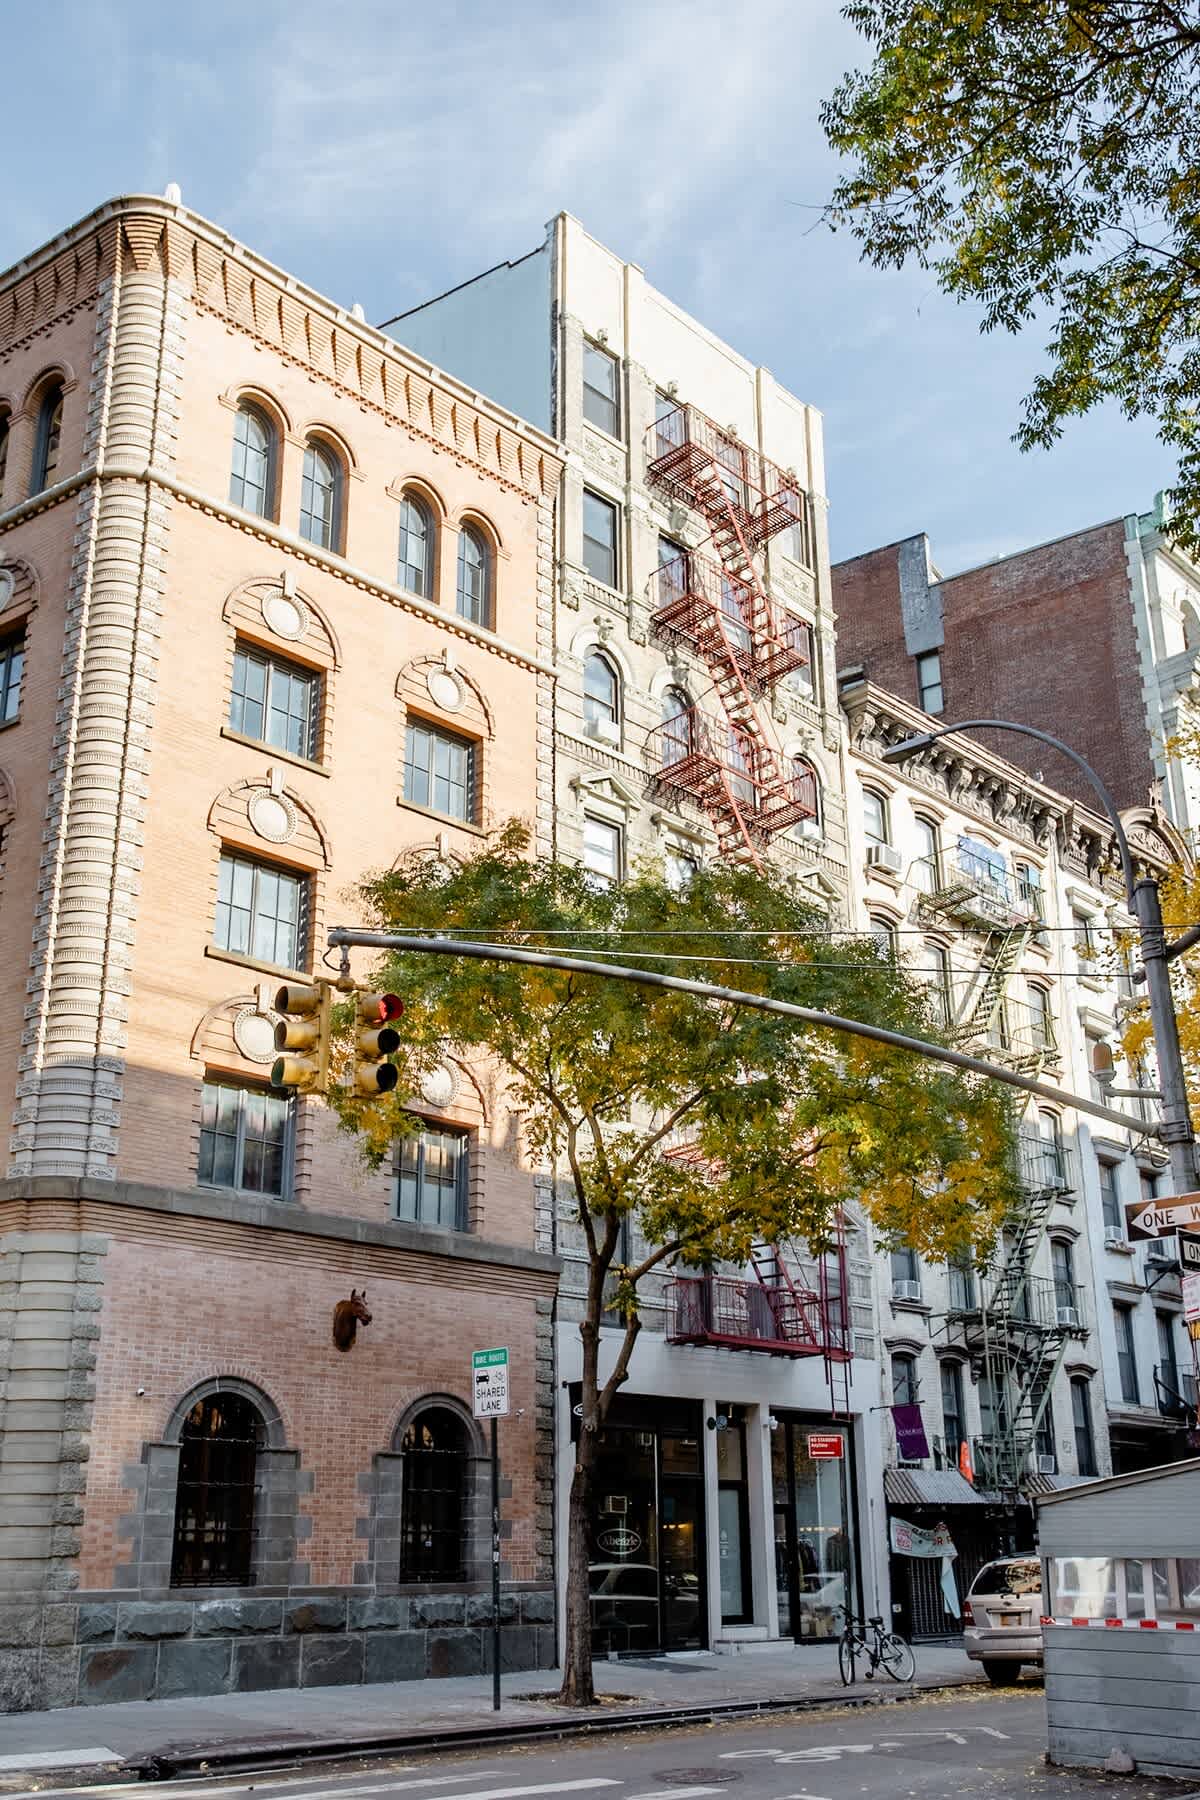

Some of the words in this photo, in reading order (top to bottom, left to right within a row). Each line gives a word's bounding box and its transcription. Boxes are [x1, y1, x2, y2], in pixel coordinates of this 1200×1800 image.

[1143, 1209, 1175, 1228] ONE
[1189, 1244, 1200, 1261] ON
[476, 1386, 505, 1399] SHARED
[481, 1400, 501, 1412] LANE
